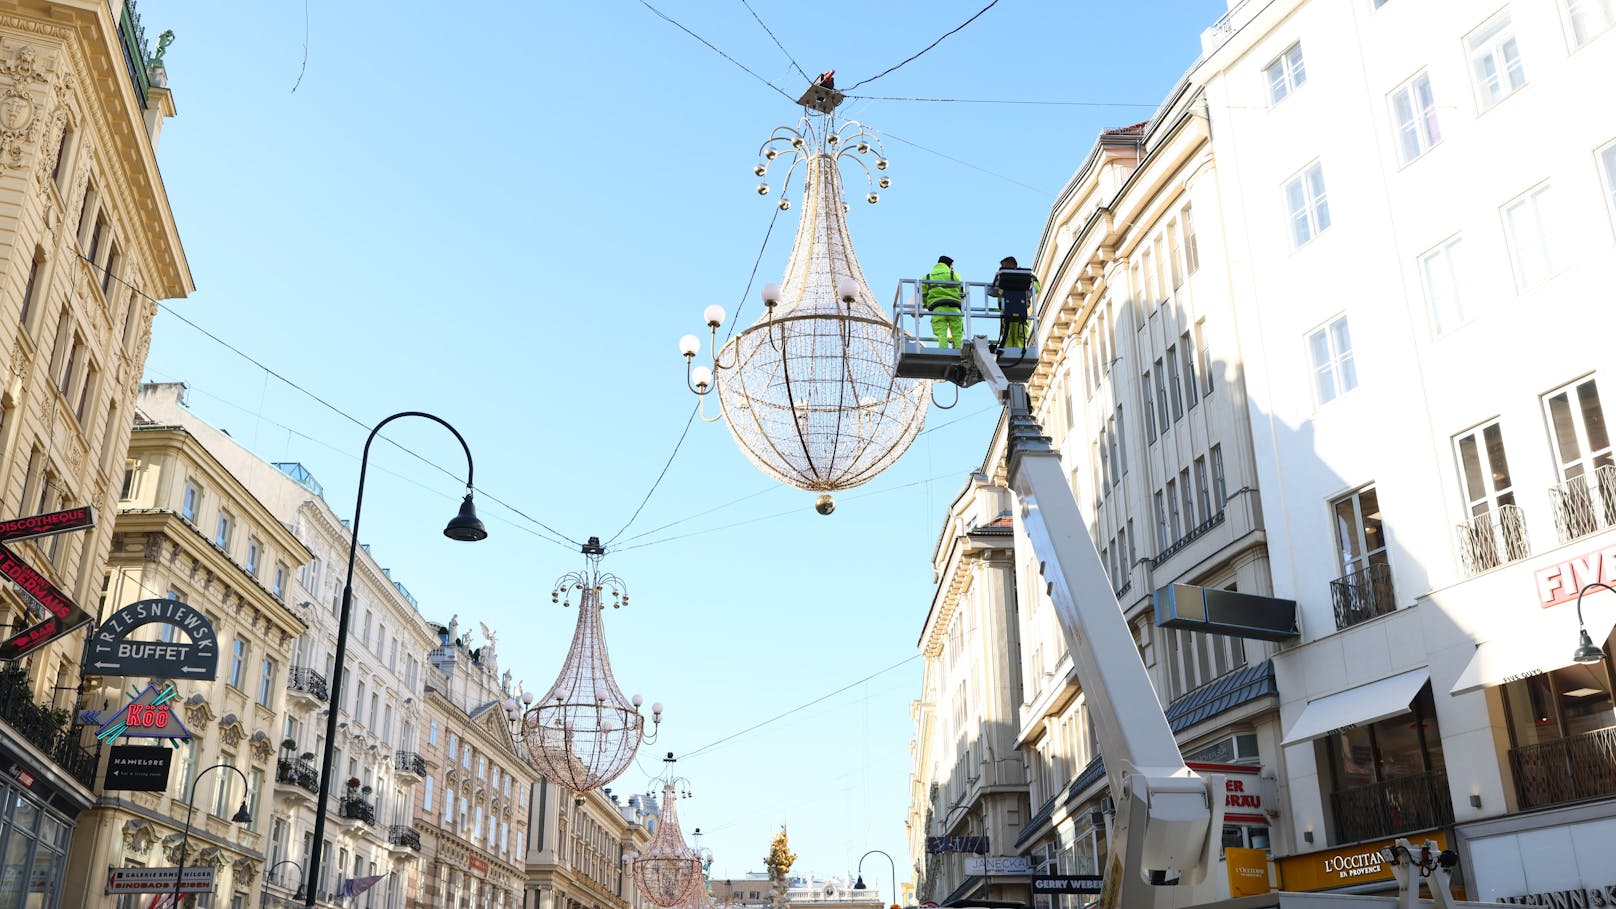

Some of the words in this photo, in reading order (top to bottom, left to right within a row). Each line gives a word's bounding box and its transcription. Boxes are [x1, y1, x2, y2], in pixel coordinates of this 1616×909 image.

[0, 509, 85, 533] DISCOTHEQUE
[30, 621, 55, 639] BAR
[118, 643, 189, 661] BUFFET
[126, 703, 169, 728] Köö
[1325, 851, 1386, 873] L'OCCITAN
[1349, 865, 1382, 876] PROVENCE
[1035, 879, 1067, 889] GERRY
[1590, 888, 1606, 907] &
